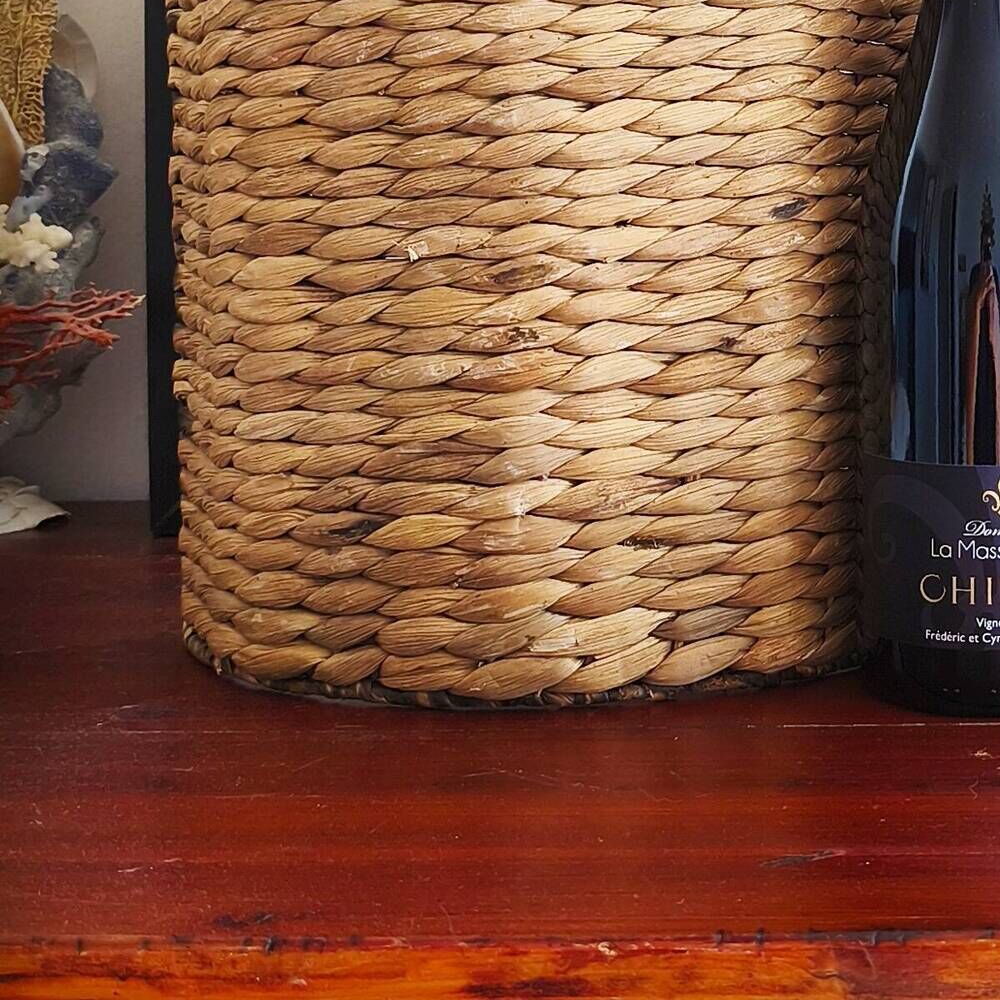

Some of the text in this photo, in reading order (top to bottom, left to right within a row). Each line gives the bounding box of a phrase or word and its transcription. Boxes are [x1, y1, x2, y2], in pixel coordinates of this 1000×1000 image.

[931, 538, 952, 558] La
[925, 629, 965, 643] Frédéric
[968, 634, 980, 643] et
